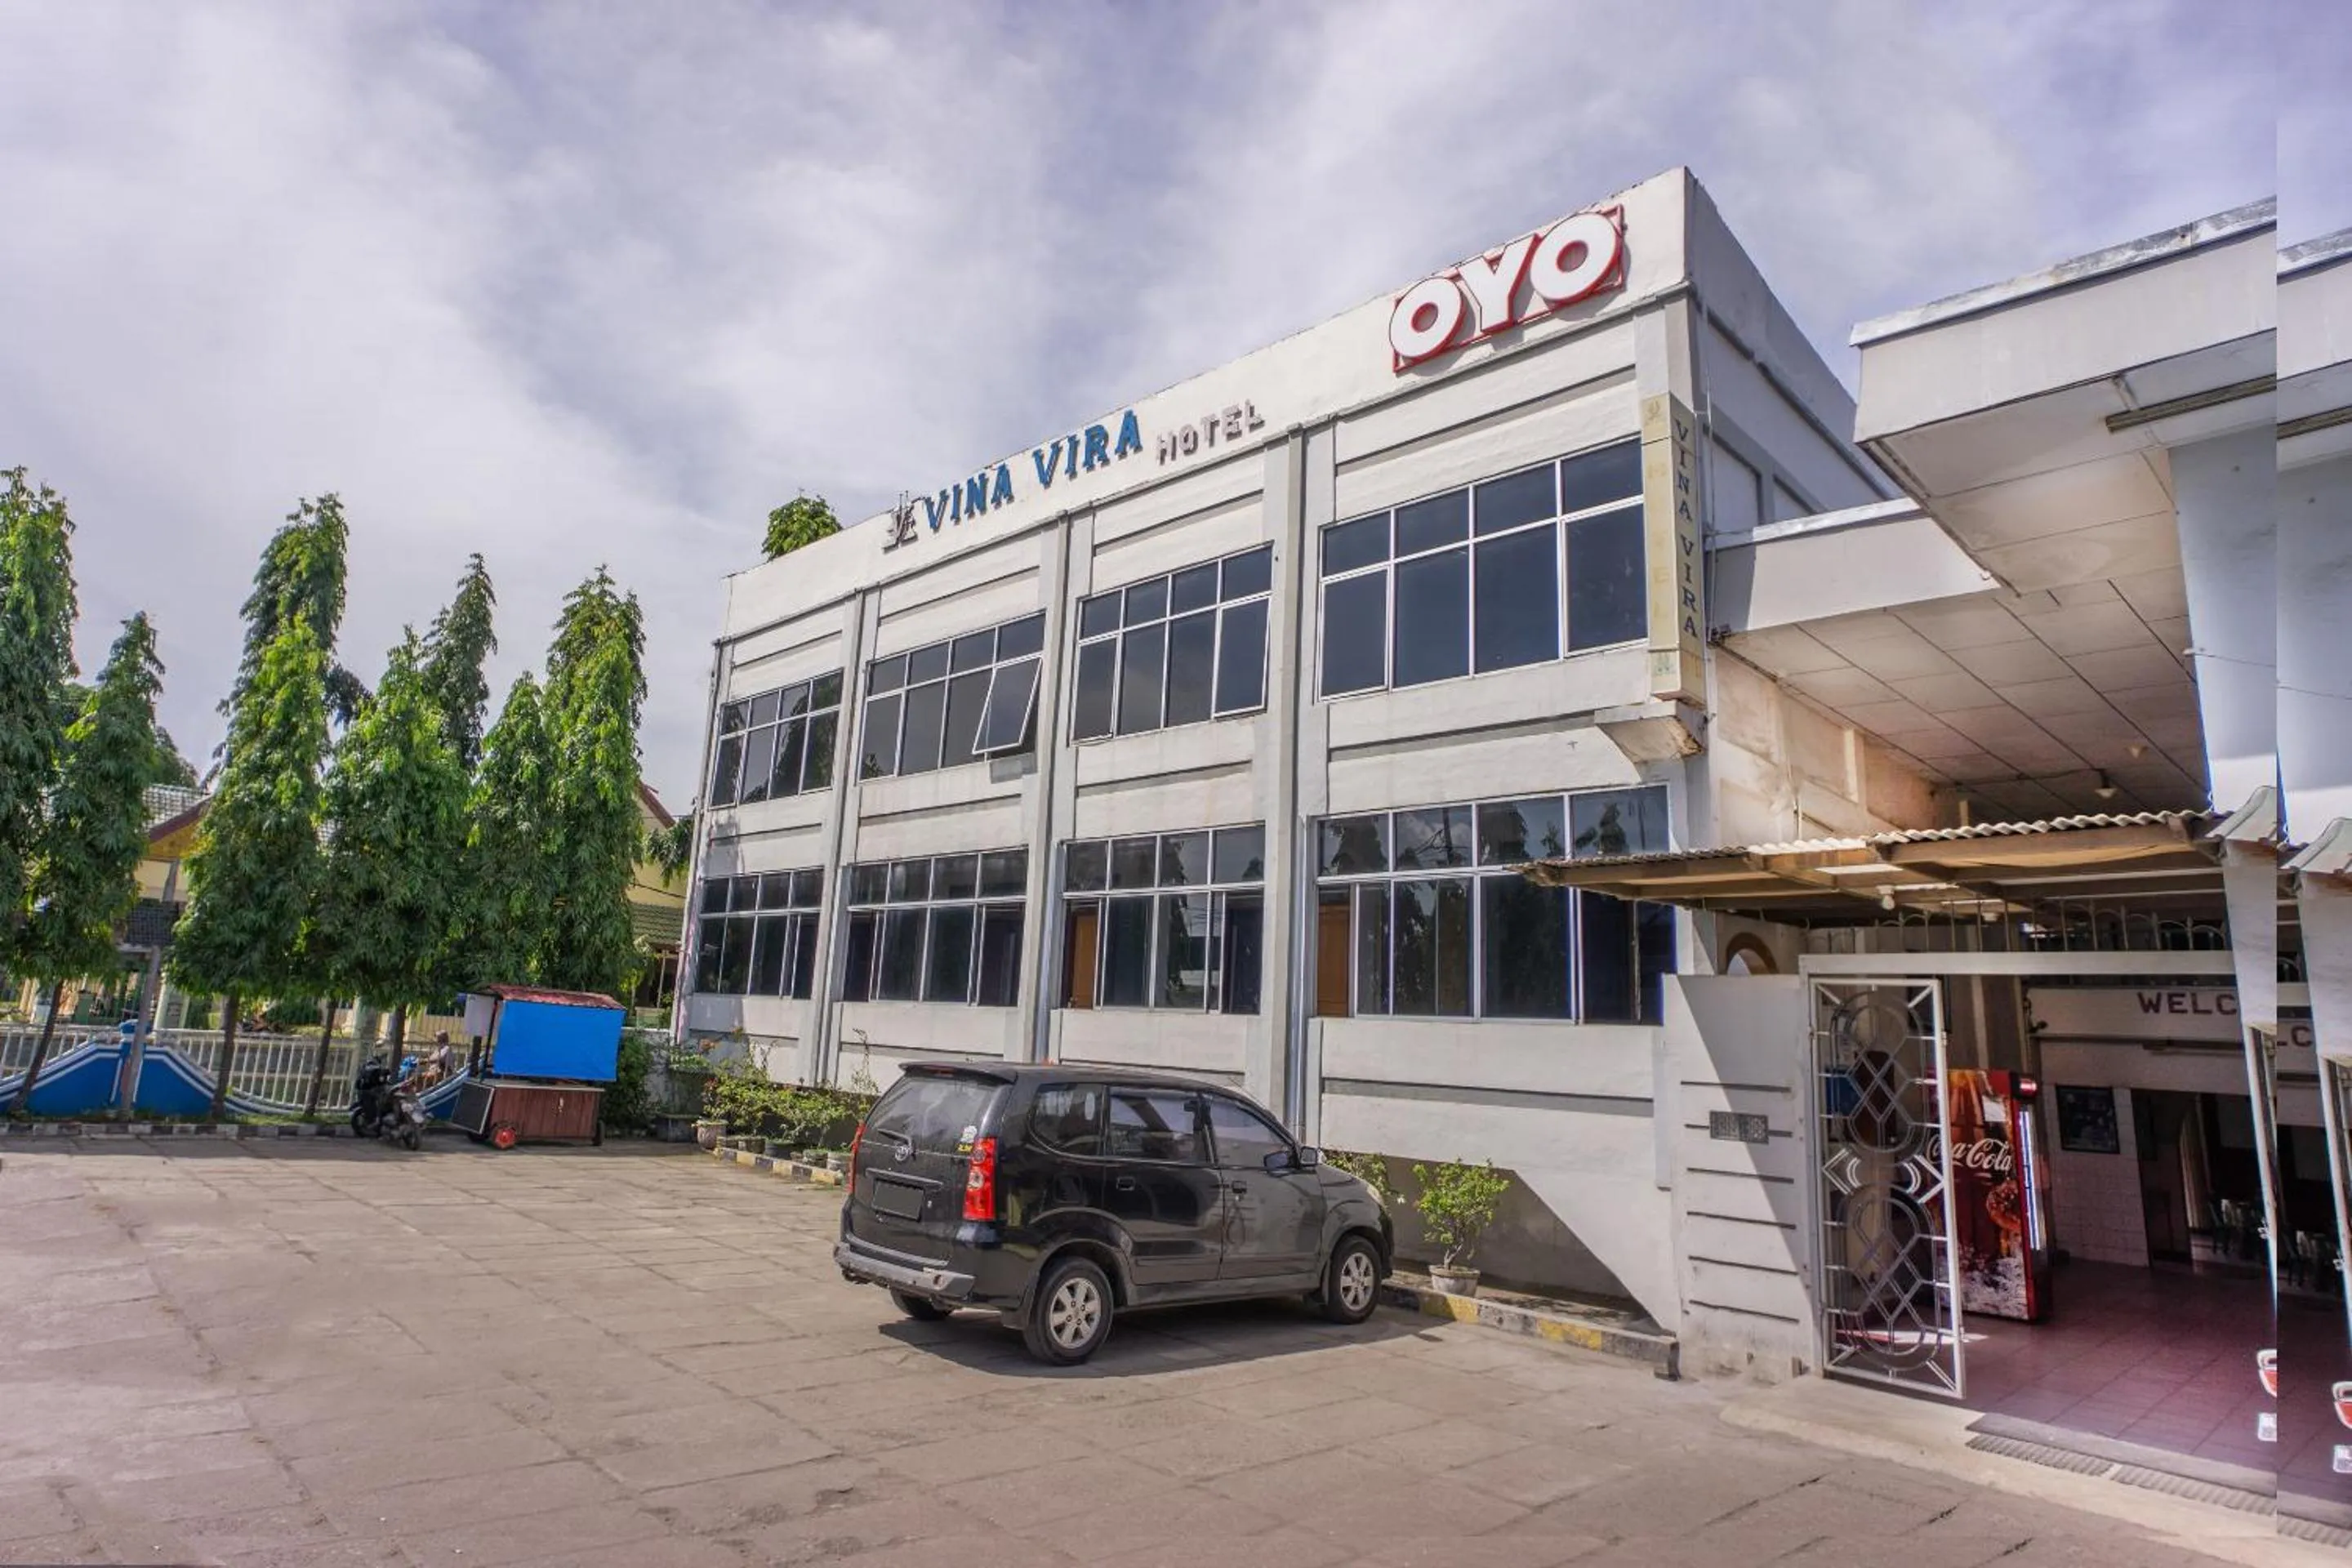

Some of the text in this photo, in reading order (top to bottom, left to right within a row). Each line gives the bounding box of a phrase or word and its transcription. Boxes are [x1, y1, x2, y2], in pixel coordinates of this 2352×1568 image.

[1389, 209, 1624, 365] OYO
[924, 399, 1265, 532] VINA VIRA HOTEL
[1675, 419, 1699, 639] VINA VIRA
